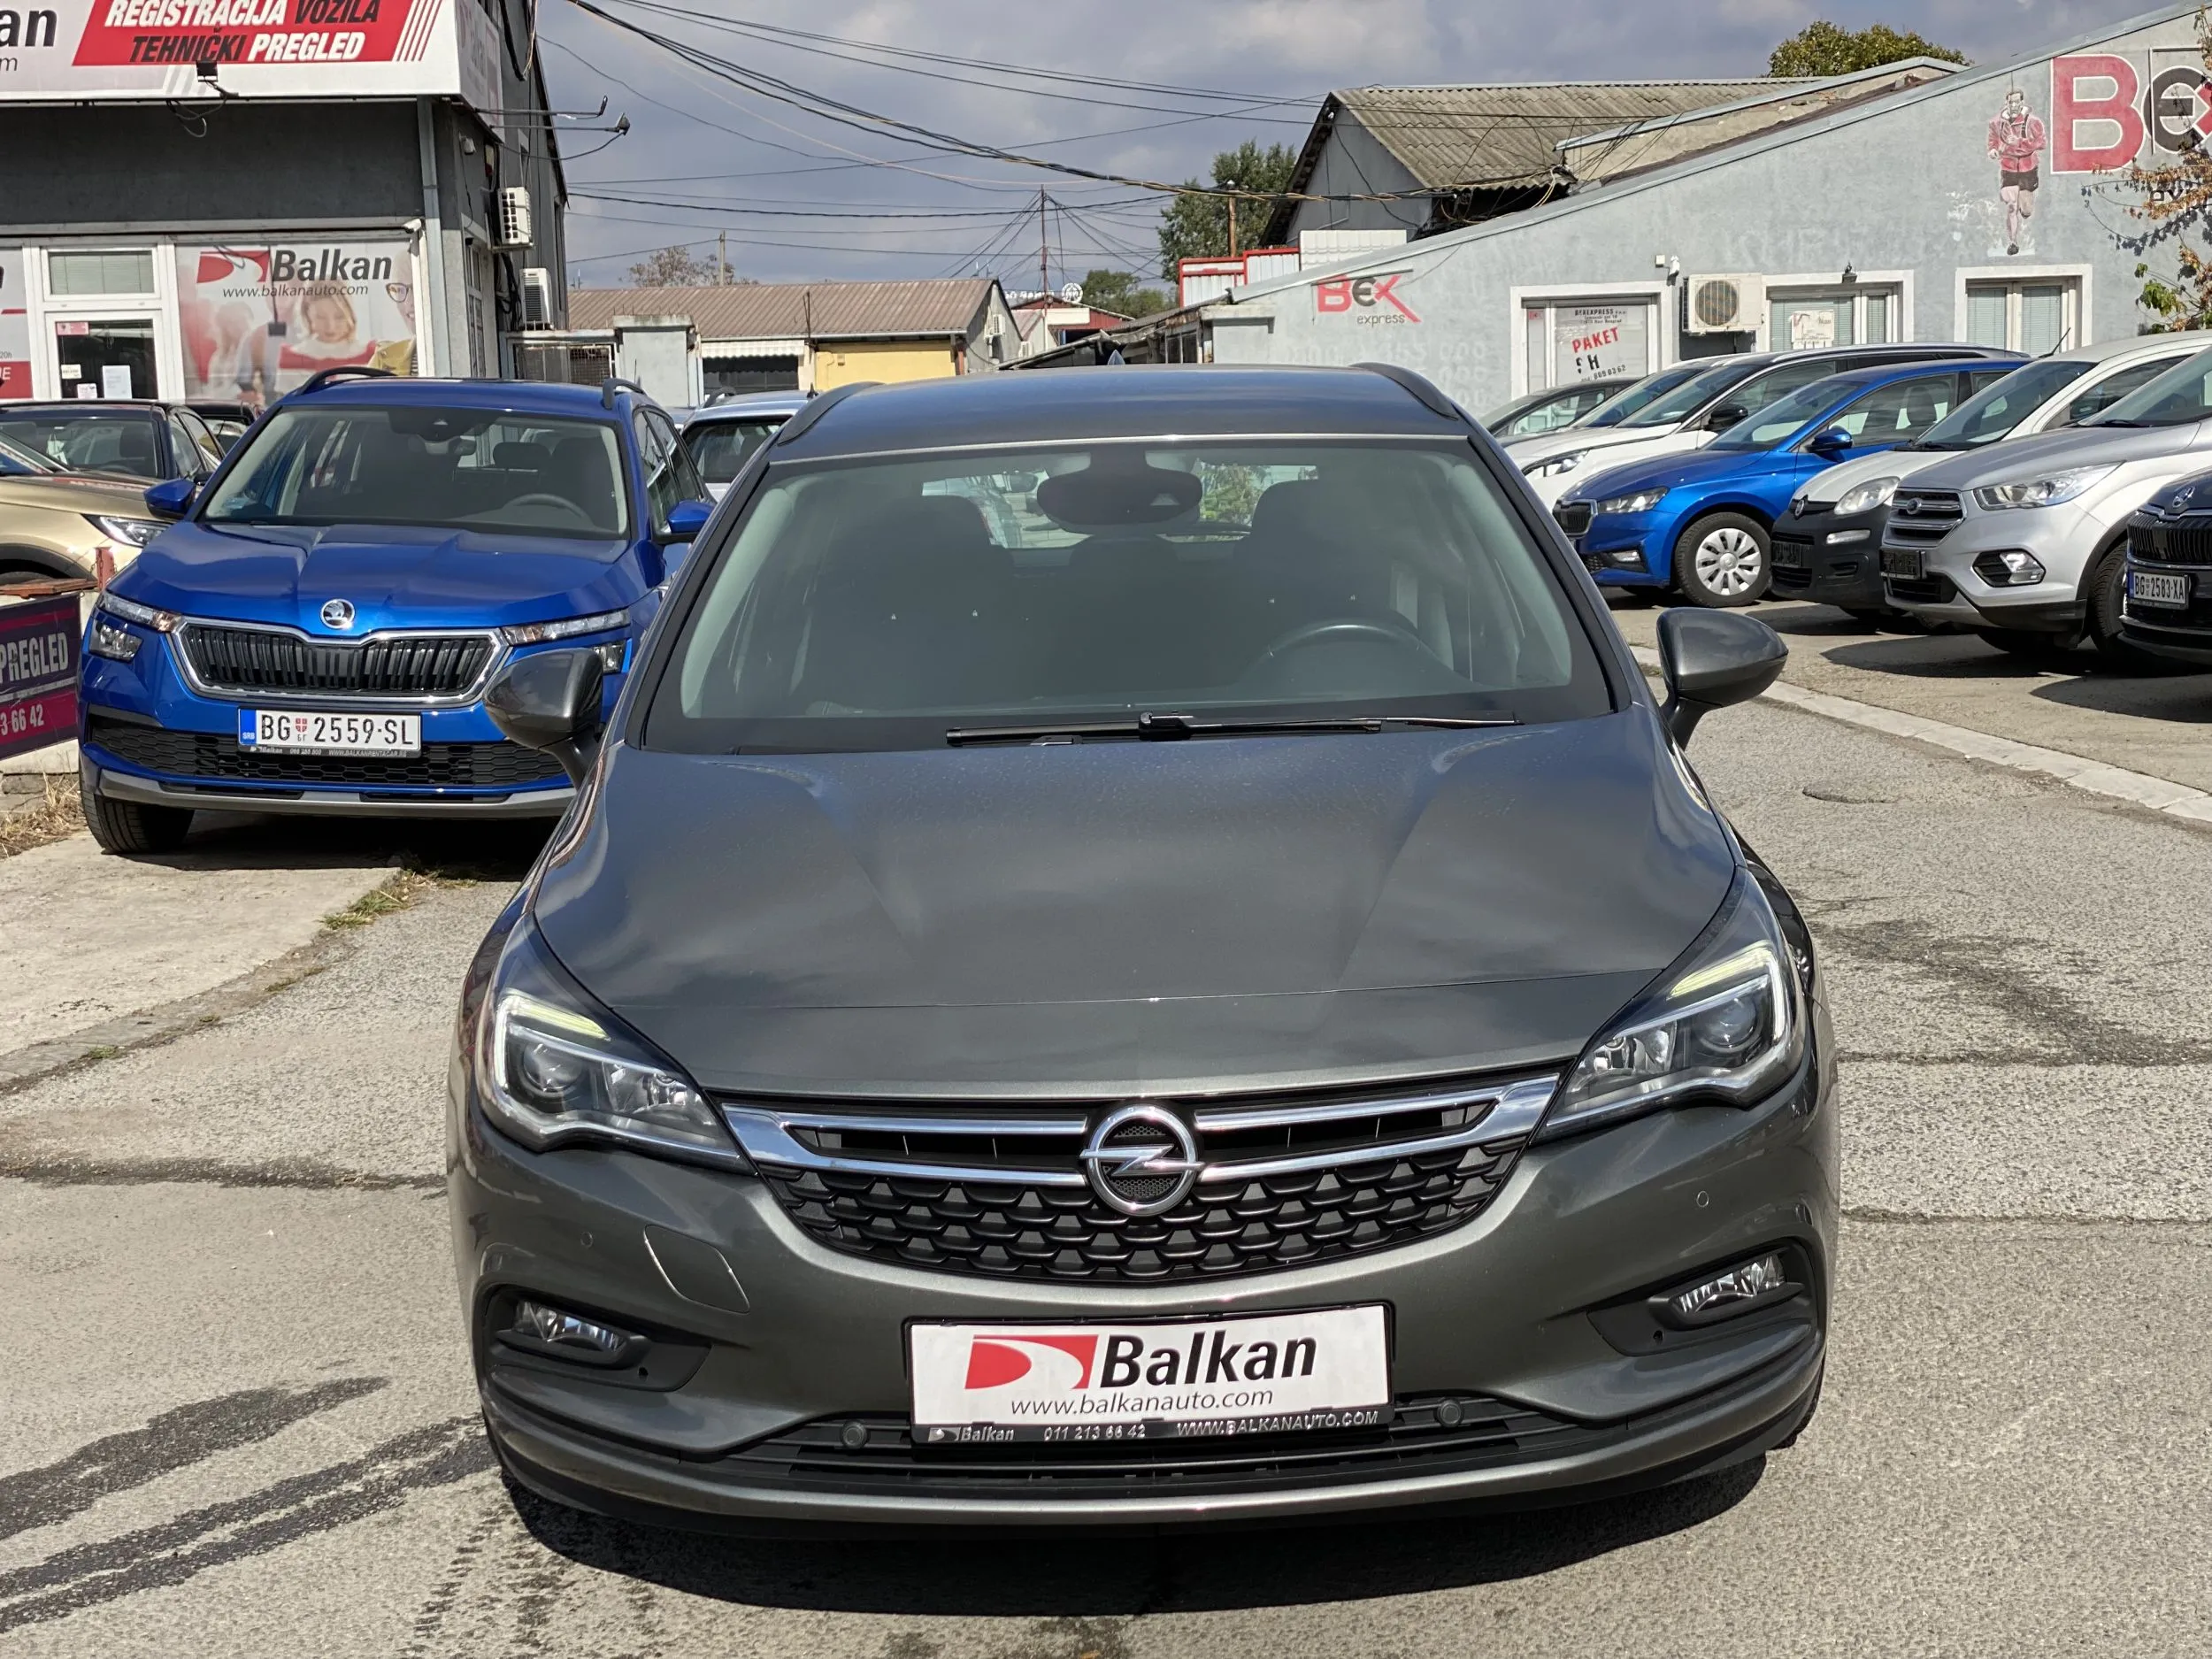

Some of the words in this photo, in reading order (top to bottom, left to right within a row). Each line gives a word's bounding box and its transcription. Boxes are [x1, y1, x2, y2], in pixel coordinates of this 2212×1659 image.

[104, 0, 288, 27] REGISTRACIJA
[295, 0, 380, 24] VOZILA
[130, 27, 248, 63] TEHNIČKI
[247, 32, 366, 62] PREGLED
[271, 248, 392, 282] Balkan
[222, 283, 369, 298] www.balkanauto.com
[1356, 313, 1406, 328] express
[1571, 326, 1619, 354] PAKET
[2135, 575, 2146, 595] BG
[12, 709, 27, 733] 66
[30, 703, 44, 727] 42
[261, 714, 291, 741] BG
[242, 731, 256, 741] SRB
[1100, 1329, 1317, 1388] Balkan
[1010, 1390, 1273, 1417] www.balkanauto.com
[960, 1426, 1015, 1442] Balkan
[1043, 1426, 1069, 1441] 011
[1074, 1425, 1101, 1440] 213
[1127, 1423, 1146, 1439] 42
[1176, 1410, 1379, 1436] WWW.BALKANAUTO.COM
